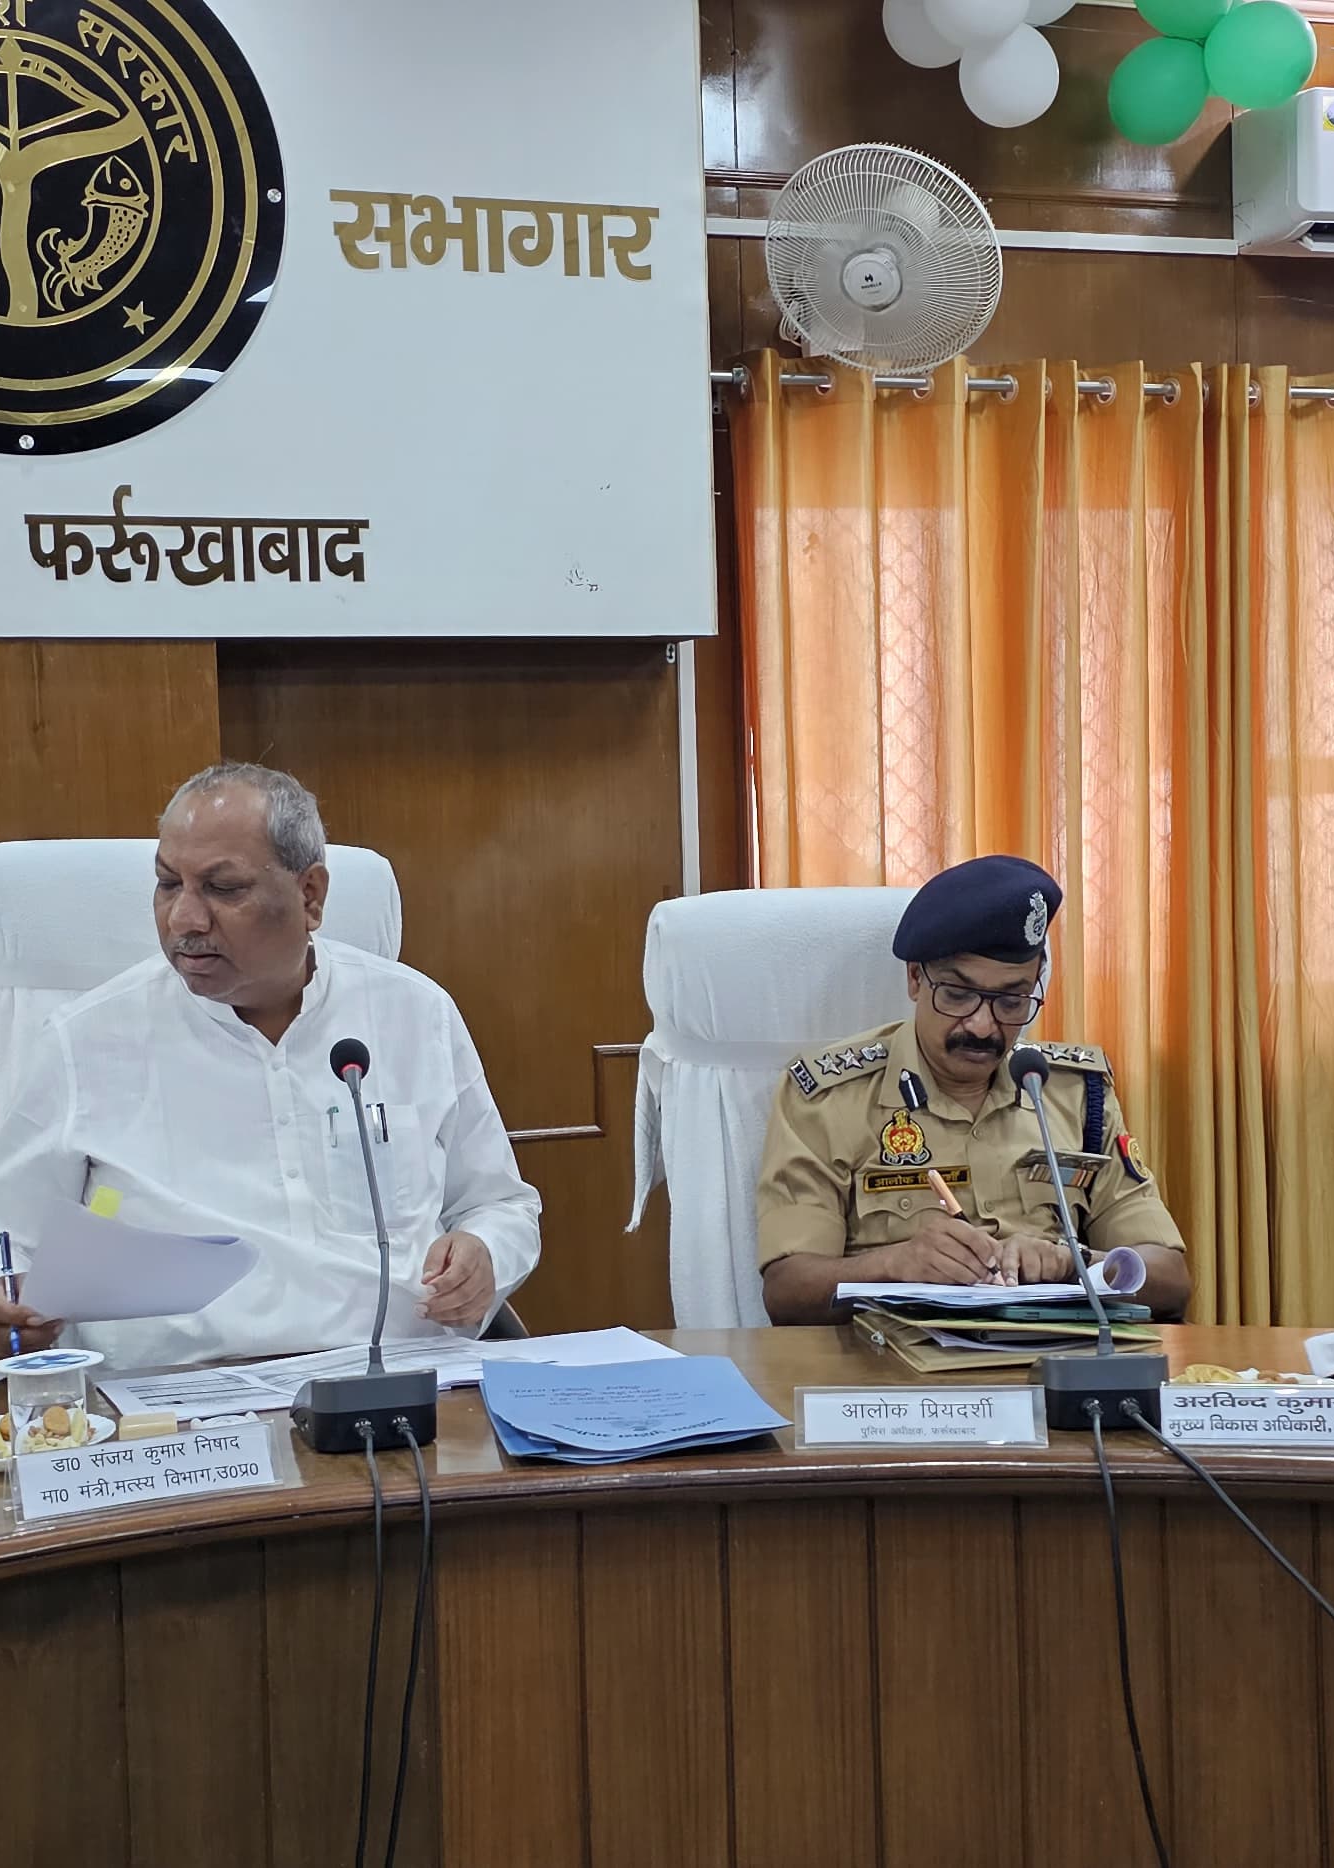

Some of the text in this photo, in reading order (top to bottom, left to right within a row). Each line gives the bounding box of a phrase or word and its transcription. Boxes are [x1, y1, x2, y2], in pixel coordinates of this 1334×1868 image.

[78, 9, 198, 163] सरकार
[330, 189, 659, 281] सभागार
[841, 1397, 995, 1419] आलोक प्रियदर्शी
[1173, 1392, 1269, 1409] अरविन्द
[1168, 1417, 1205, 1437] मुख्य
[1210, 1414, 1258, 1432] विकास
[1262, 1414, 1332, 1433] अधिकारी,
[90, 1449, 133, 1469] संजय
[144, 1442, 185, 1465] कुमार
[194, 1434, 241, 1454] निषाद
